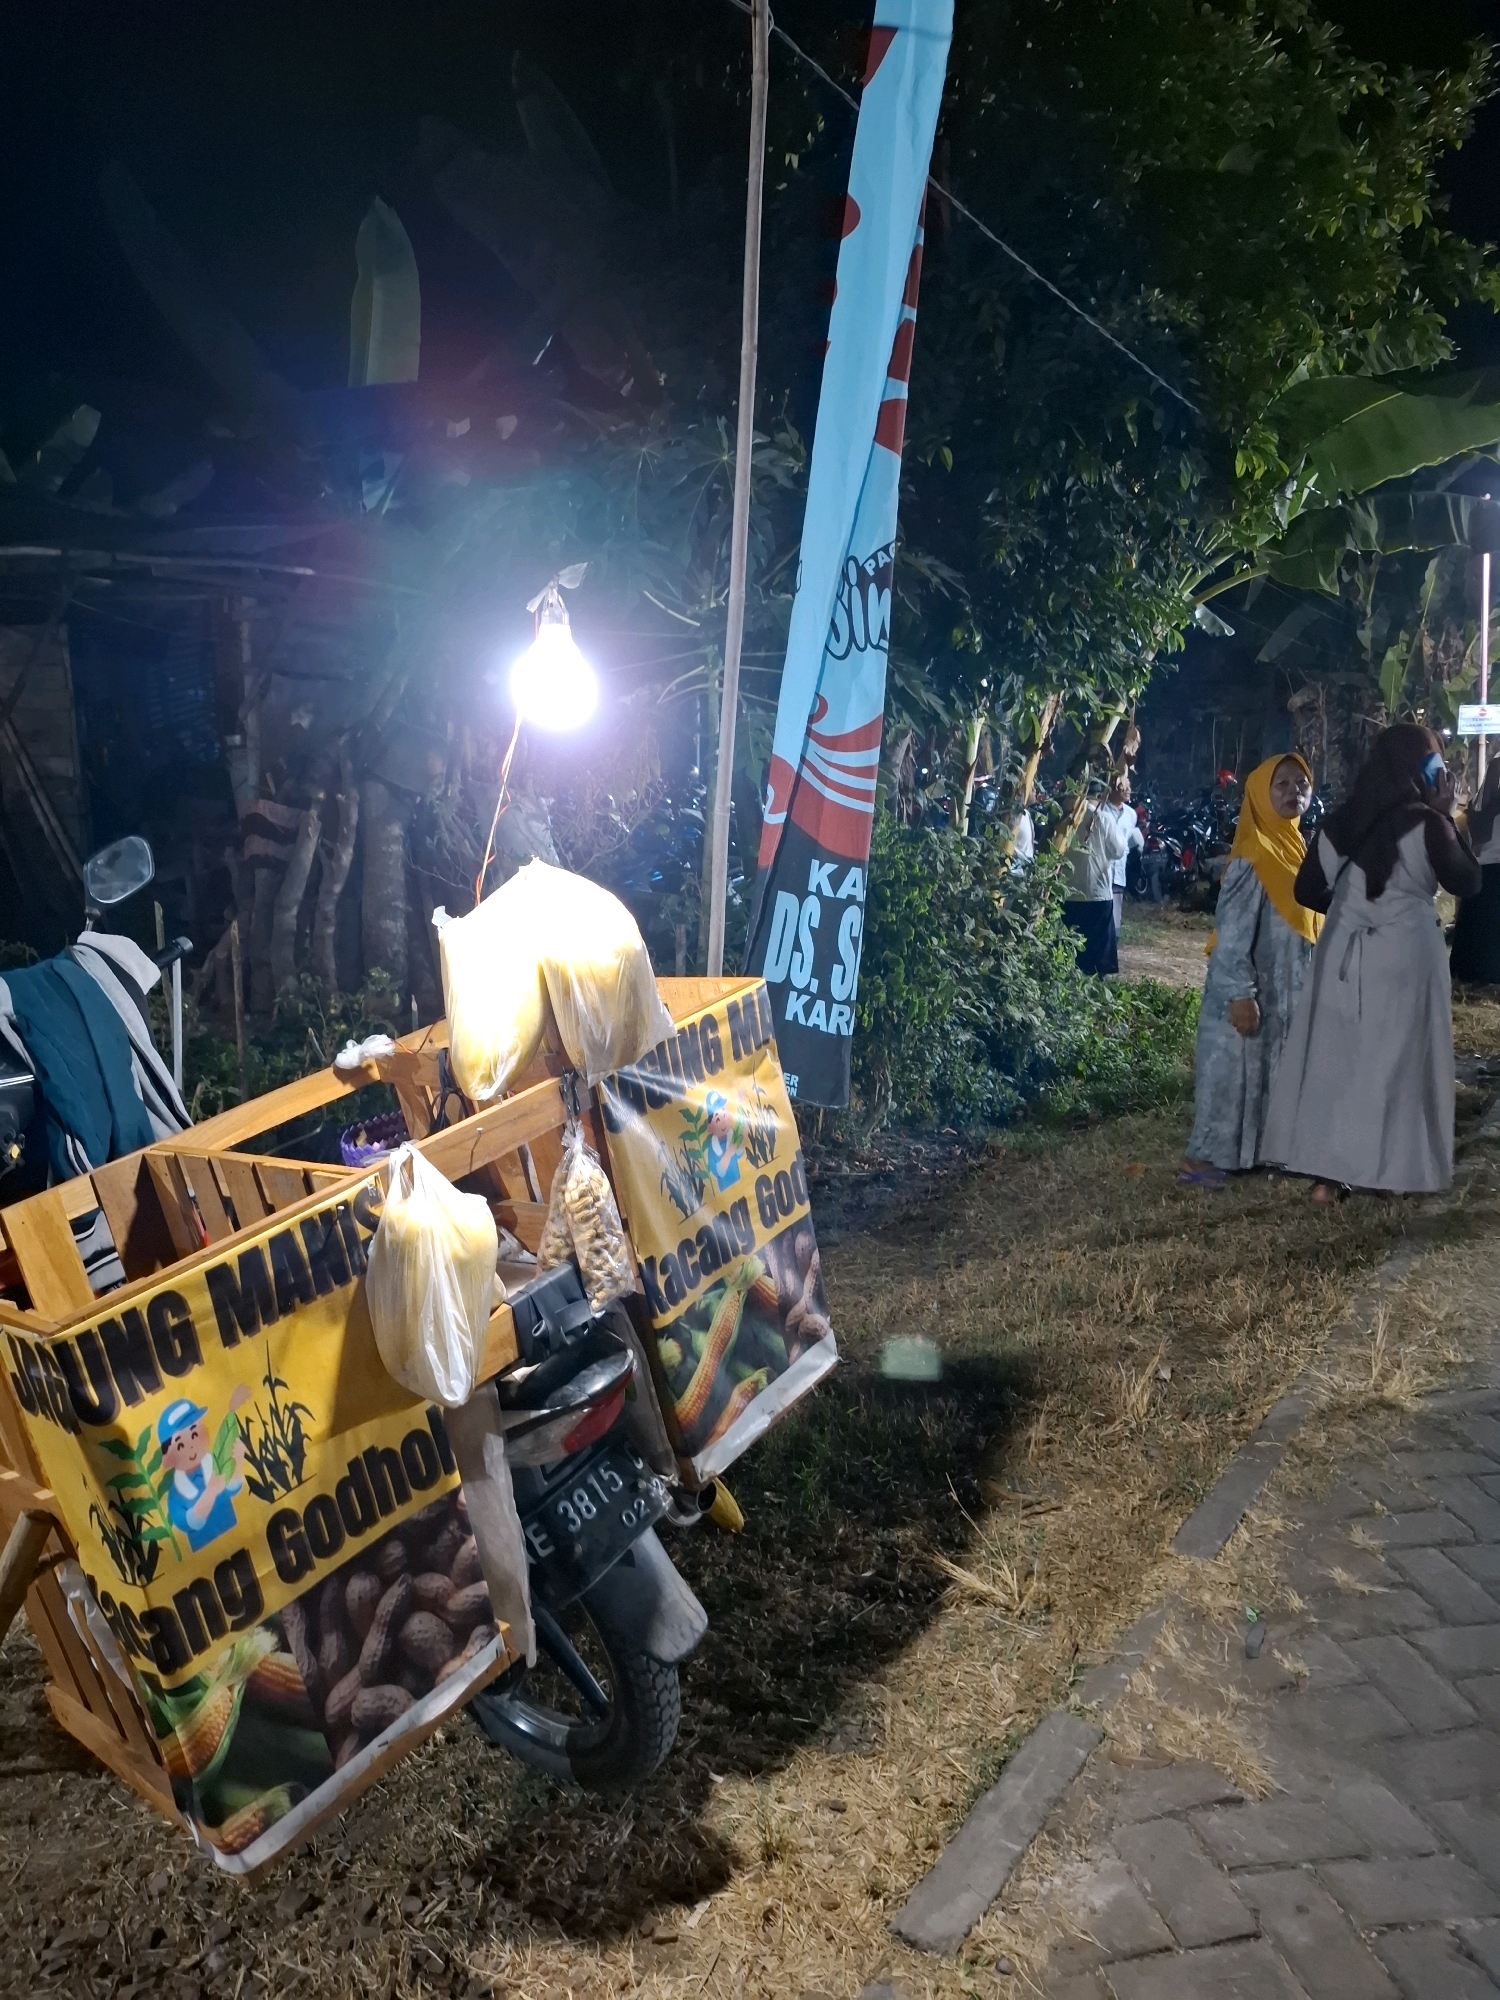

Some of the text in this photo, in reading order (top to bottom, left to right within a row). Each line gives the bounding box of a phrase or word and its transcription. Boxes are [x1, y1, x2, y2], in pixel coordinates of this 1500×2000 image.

[763, 890, 821, 994] DS.
[556, 1461, 623, 1534] 3815
[621, 1498, 650, 1528] 02
